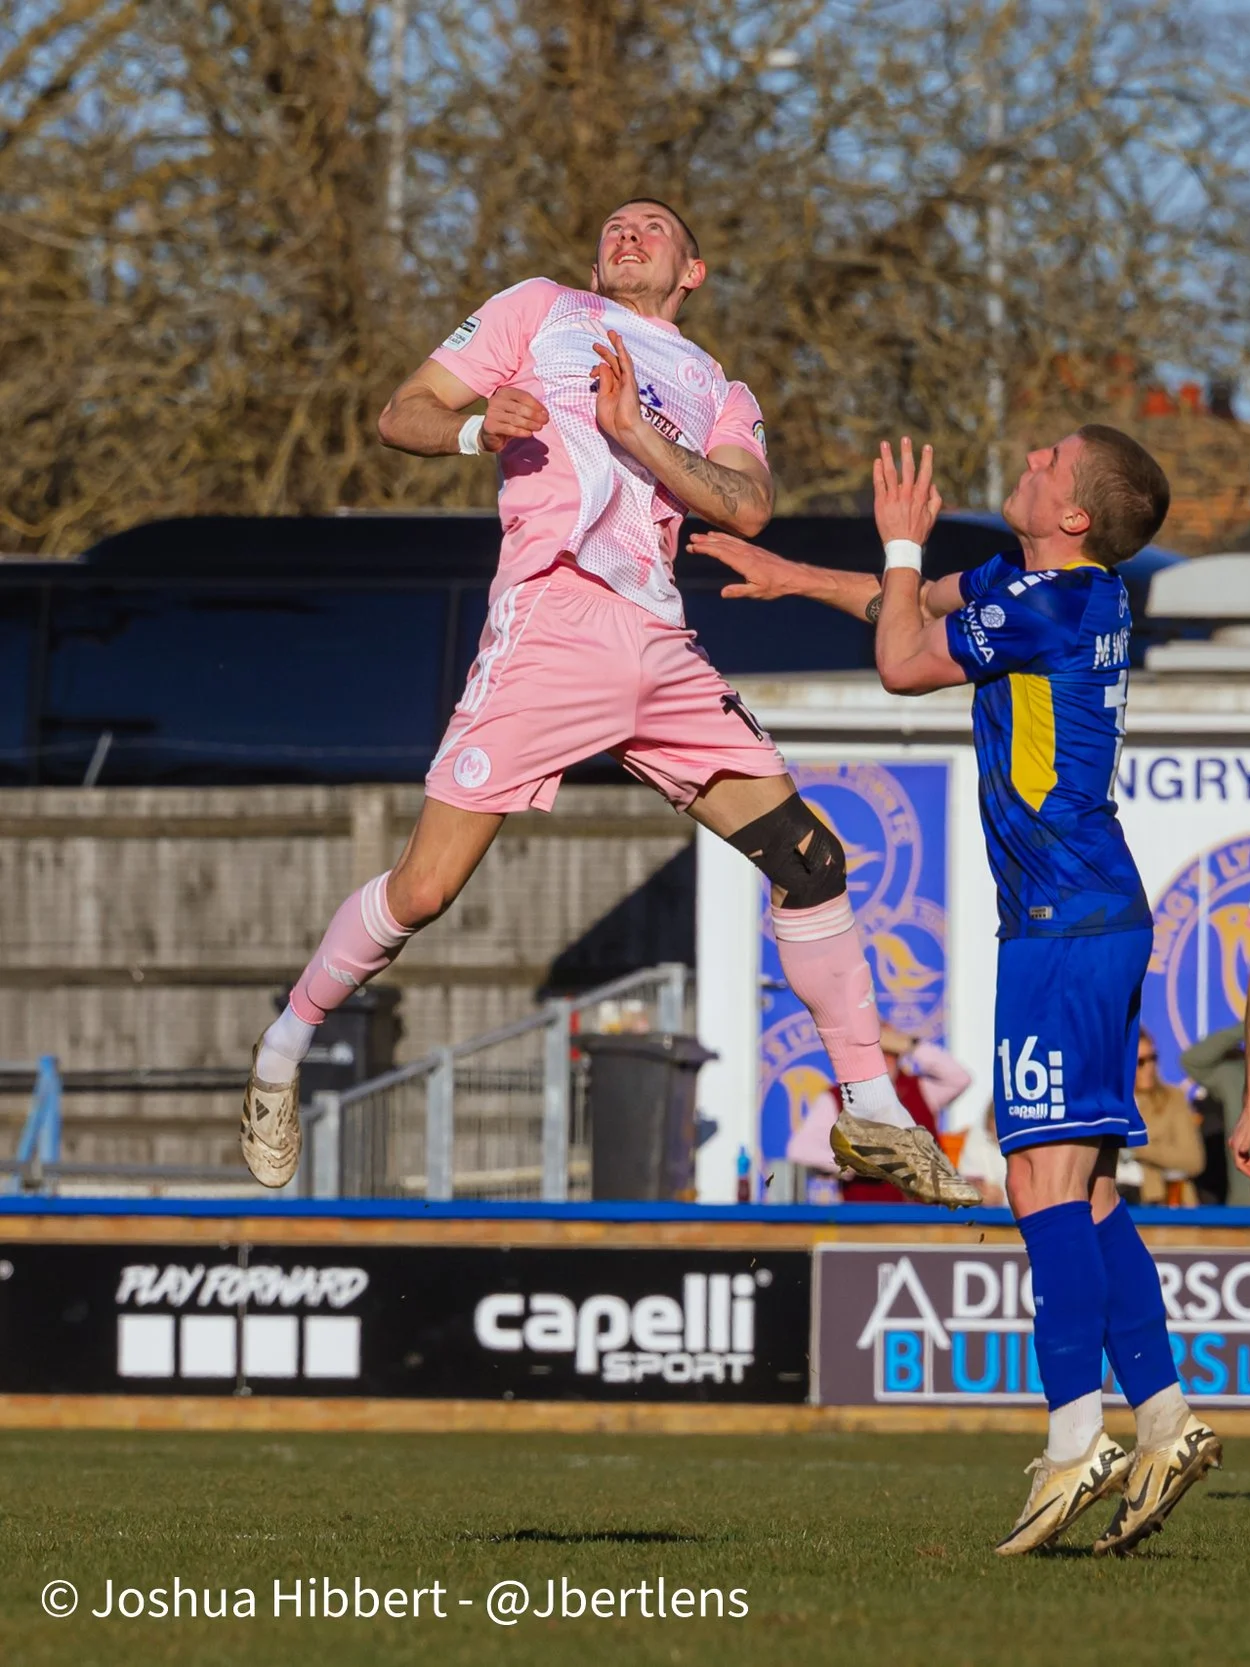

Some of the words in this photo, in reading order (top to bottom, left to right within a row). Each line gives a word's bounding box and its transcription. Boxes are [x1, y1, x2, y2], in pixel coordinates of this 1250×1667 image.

[644, 407, 683, 441] STEELS
[998, 1035, 1049, 1101] 16
[116, 1264, 205, 1307] PLAY
[197, 1264, 369, 1308] FORWARD
[474, 1272, 755, 1374] capelli
[602, 1352, 755, 1383] SPORT
